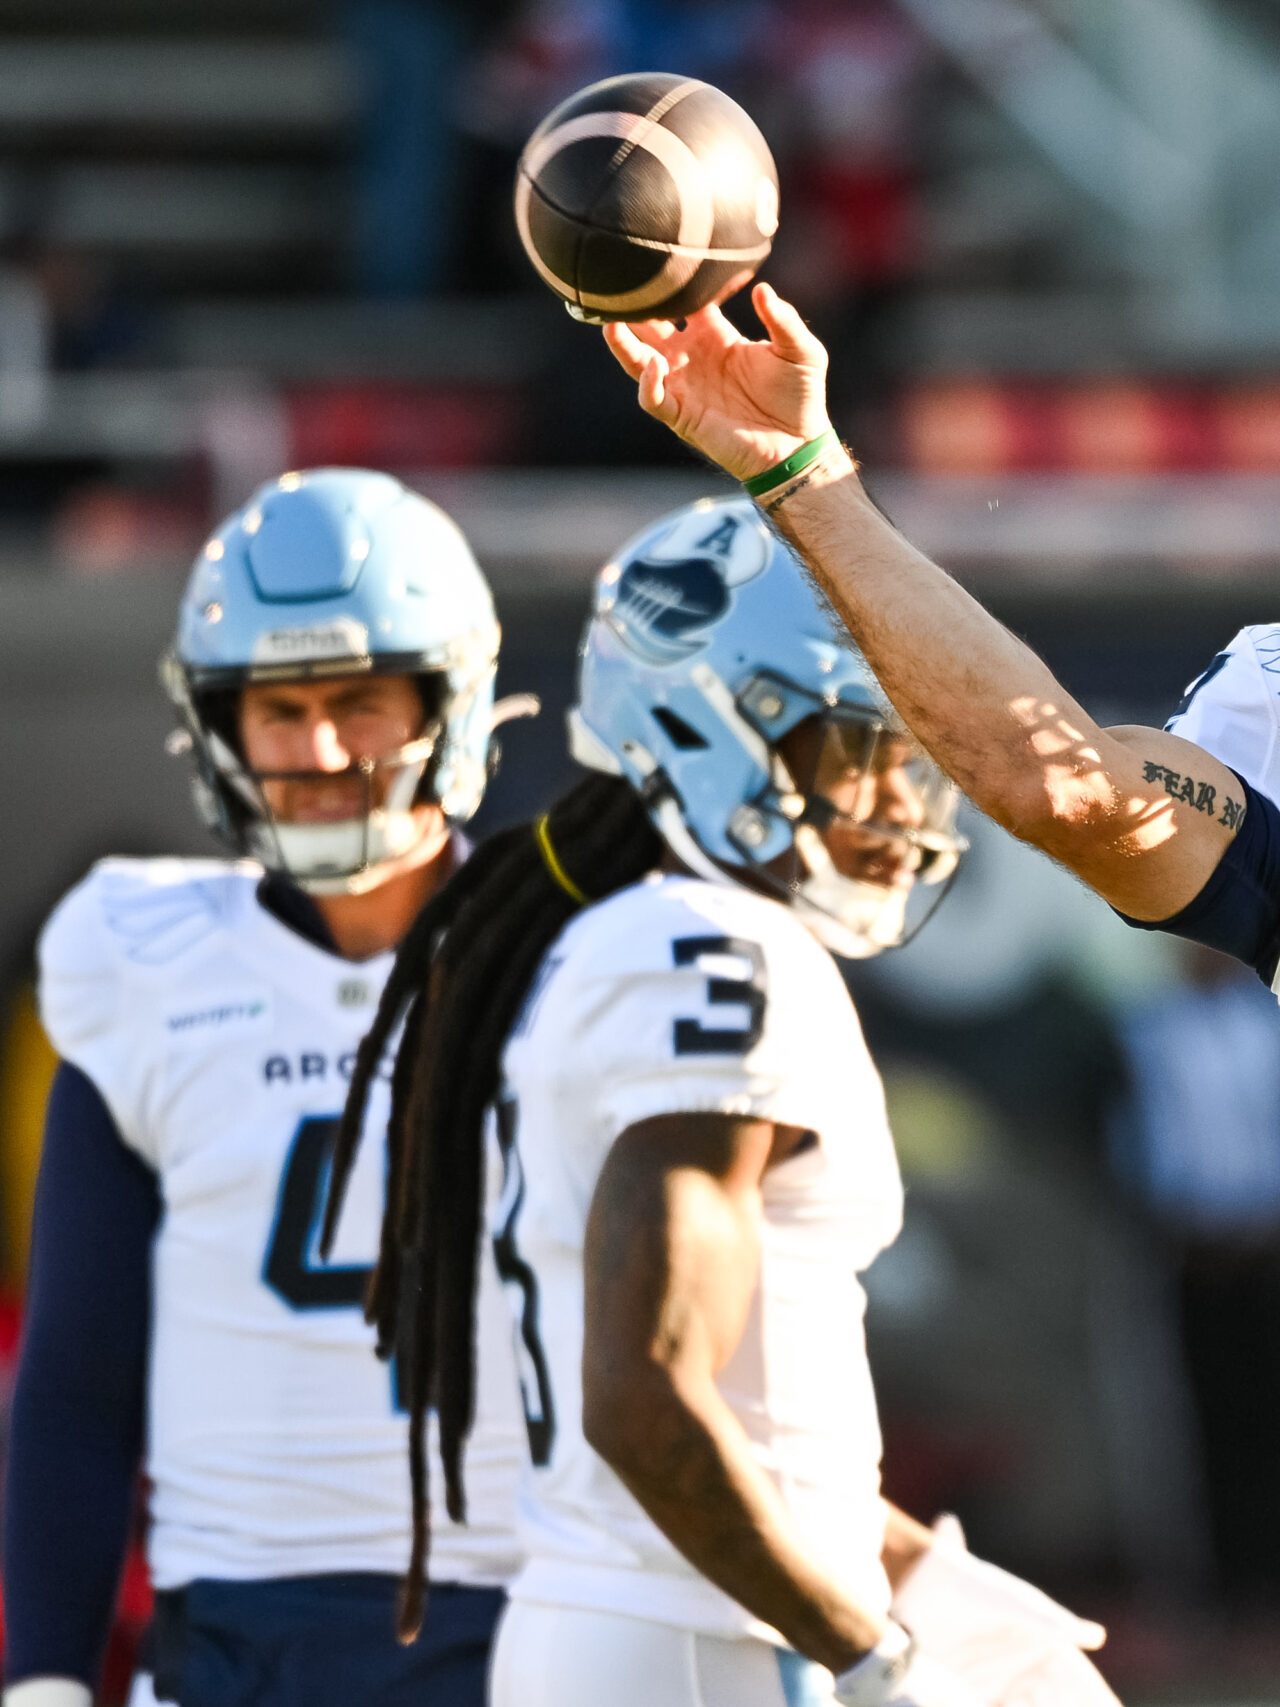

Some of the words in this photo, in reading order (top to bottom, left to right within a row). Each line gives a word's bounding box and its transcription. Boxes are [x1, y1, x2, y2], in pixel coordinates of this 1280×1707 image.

[696, 516, 740, 556] A
[1142, 760, 1217, 816] FEAR
[671, 936, 768, 1057] 3
